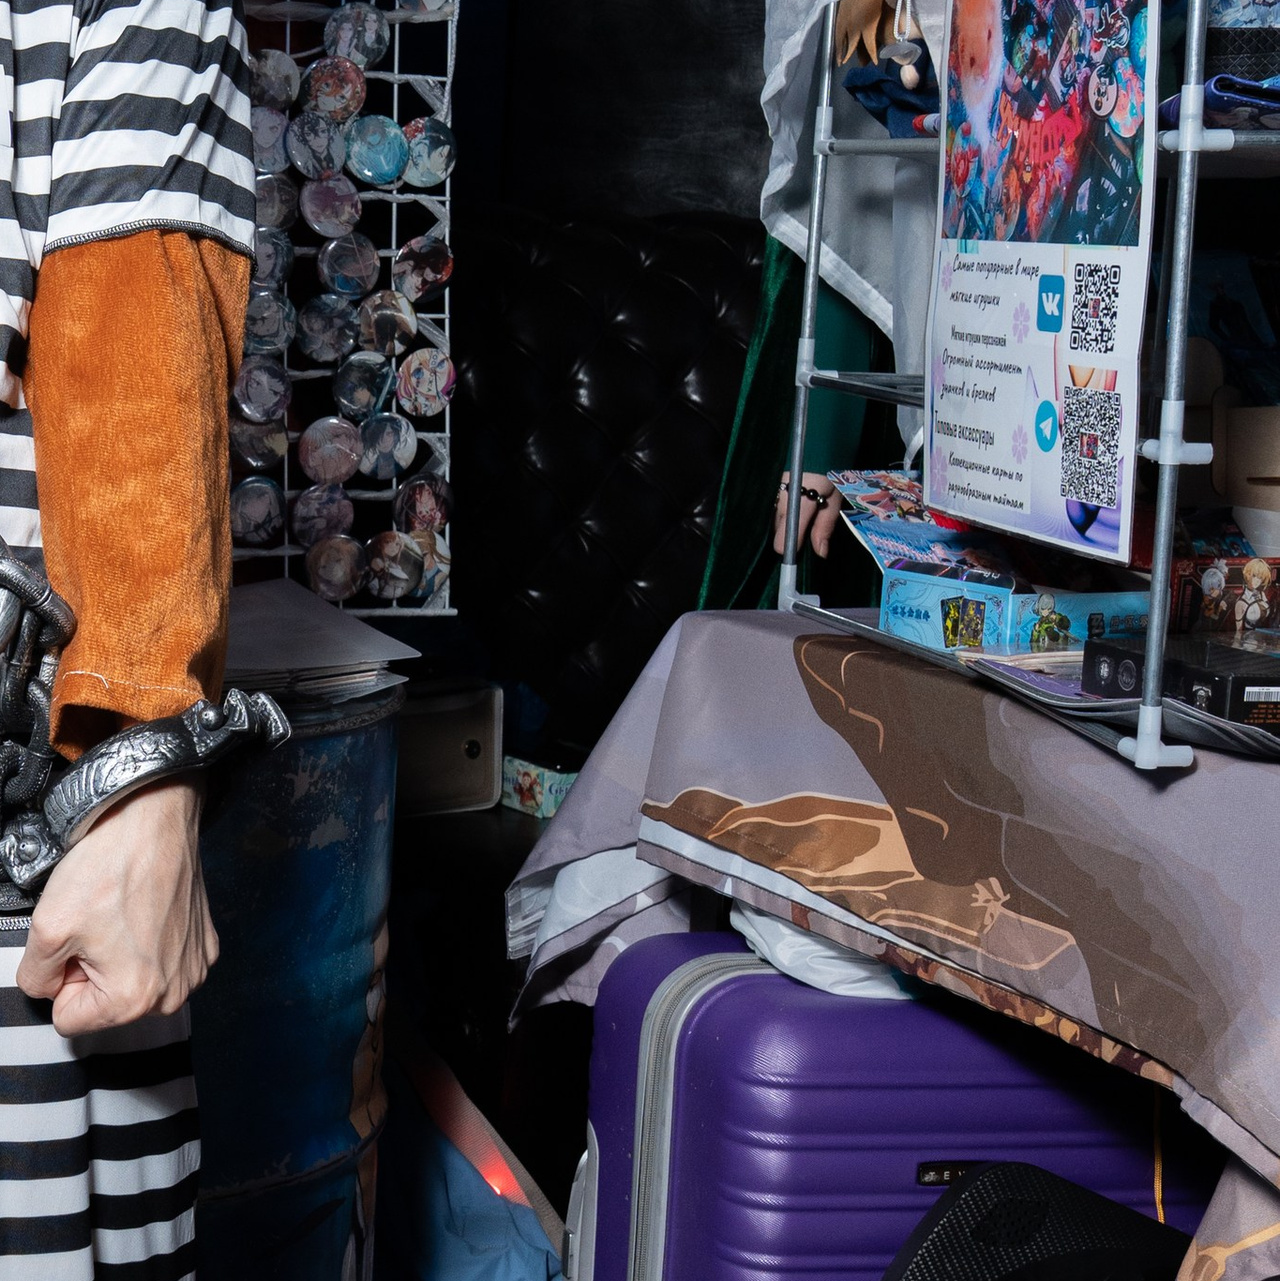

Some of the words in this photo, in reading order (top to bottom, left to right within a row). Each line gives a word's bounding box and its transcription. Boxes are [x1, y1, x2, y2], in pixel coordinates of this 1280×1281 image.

[953, 254, 975, 272] Самые
[976, 261, 1013, 280] популярные
[1015, 257, 1021, 276] в
[1021, 265, 1040, 280] мире
[950, 291, 972, 303] мягкие
[973, 294, 1000, 310] игрушки
[942, 348, 974, 369] Огромный
[975, 359, 1022, 376] ассортимент
[940, 381, 966, 400] значков
[966, 388, 971, 398] и
[934, 410, 957, 438] Топовые
[957, 425, 995, 451] аксессуары
[991, 466, 1014, 481] карты
[1015, 472, 1023, 482] по
[947, 482, 992, 502] разнообразным
[993, 493, 1024, 511] тайтлам
